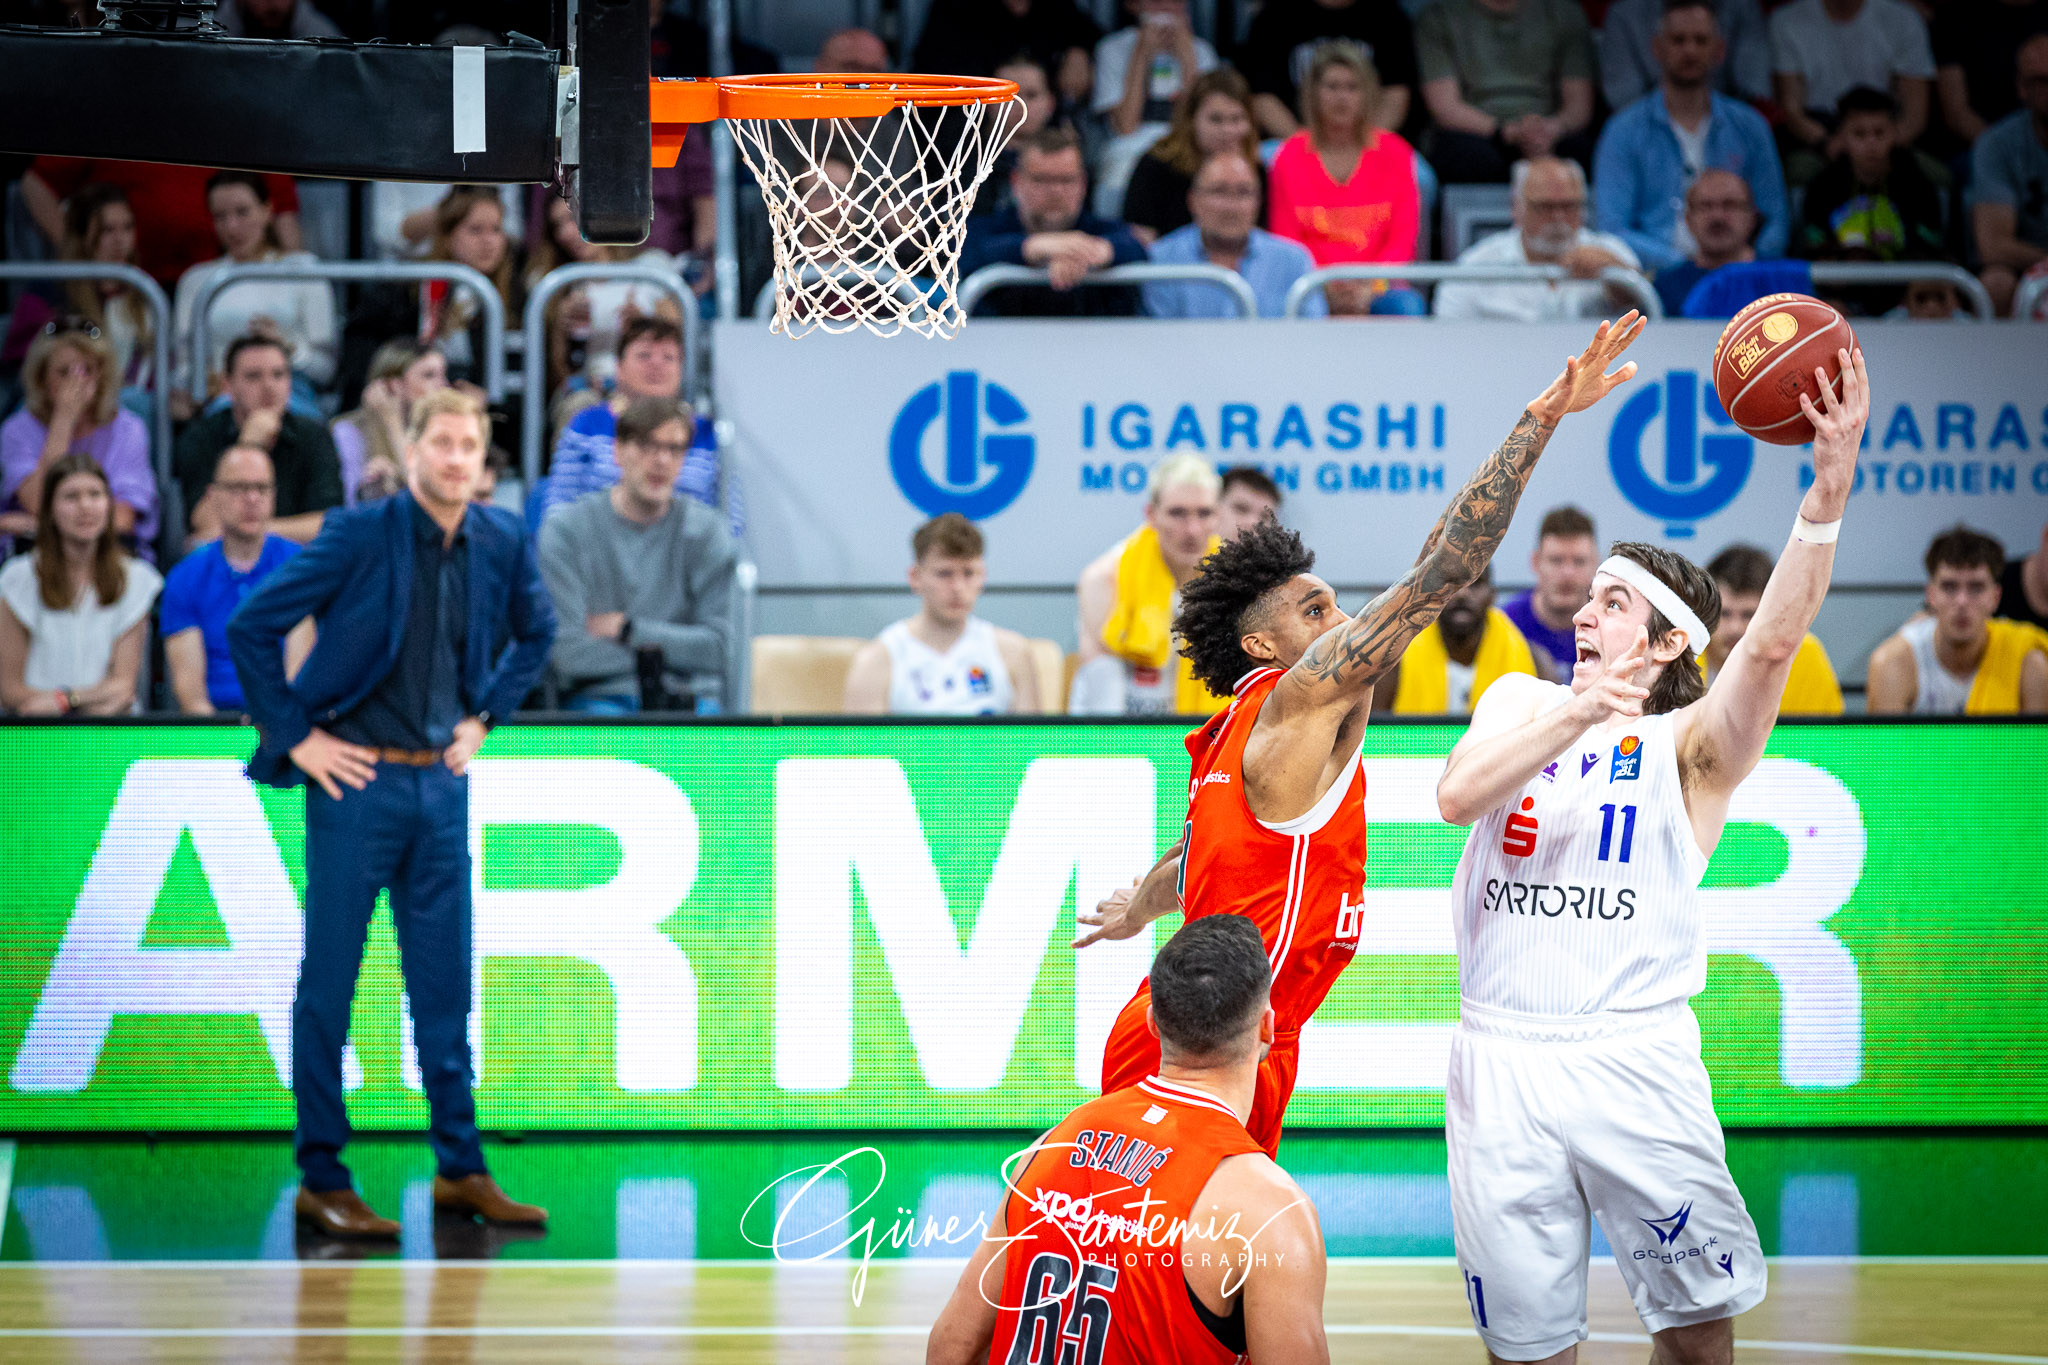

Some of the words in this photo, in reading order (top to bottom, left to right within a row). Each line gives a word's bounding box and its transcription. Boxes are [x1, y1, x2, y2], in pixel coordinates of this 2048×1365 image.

[1738, 343, 1767, 374] BBL
[1082, 402, 1446, 450] IGARASHI
[1316, 461, 1445, 494] GMBH
[1597, 803, 1637, 863] 11
[1483, 878, 1636, 921] SARTORIUS
[1070, 1129, 1174, 1187] STANIĆ
[1004, 1252, 1119, 1365] 65
